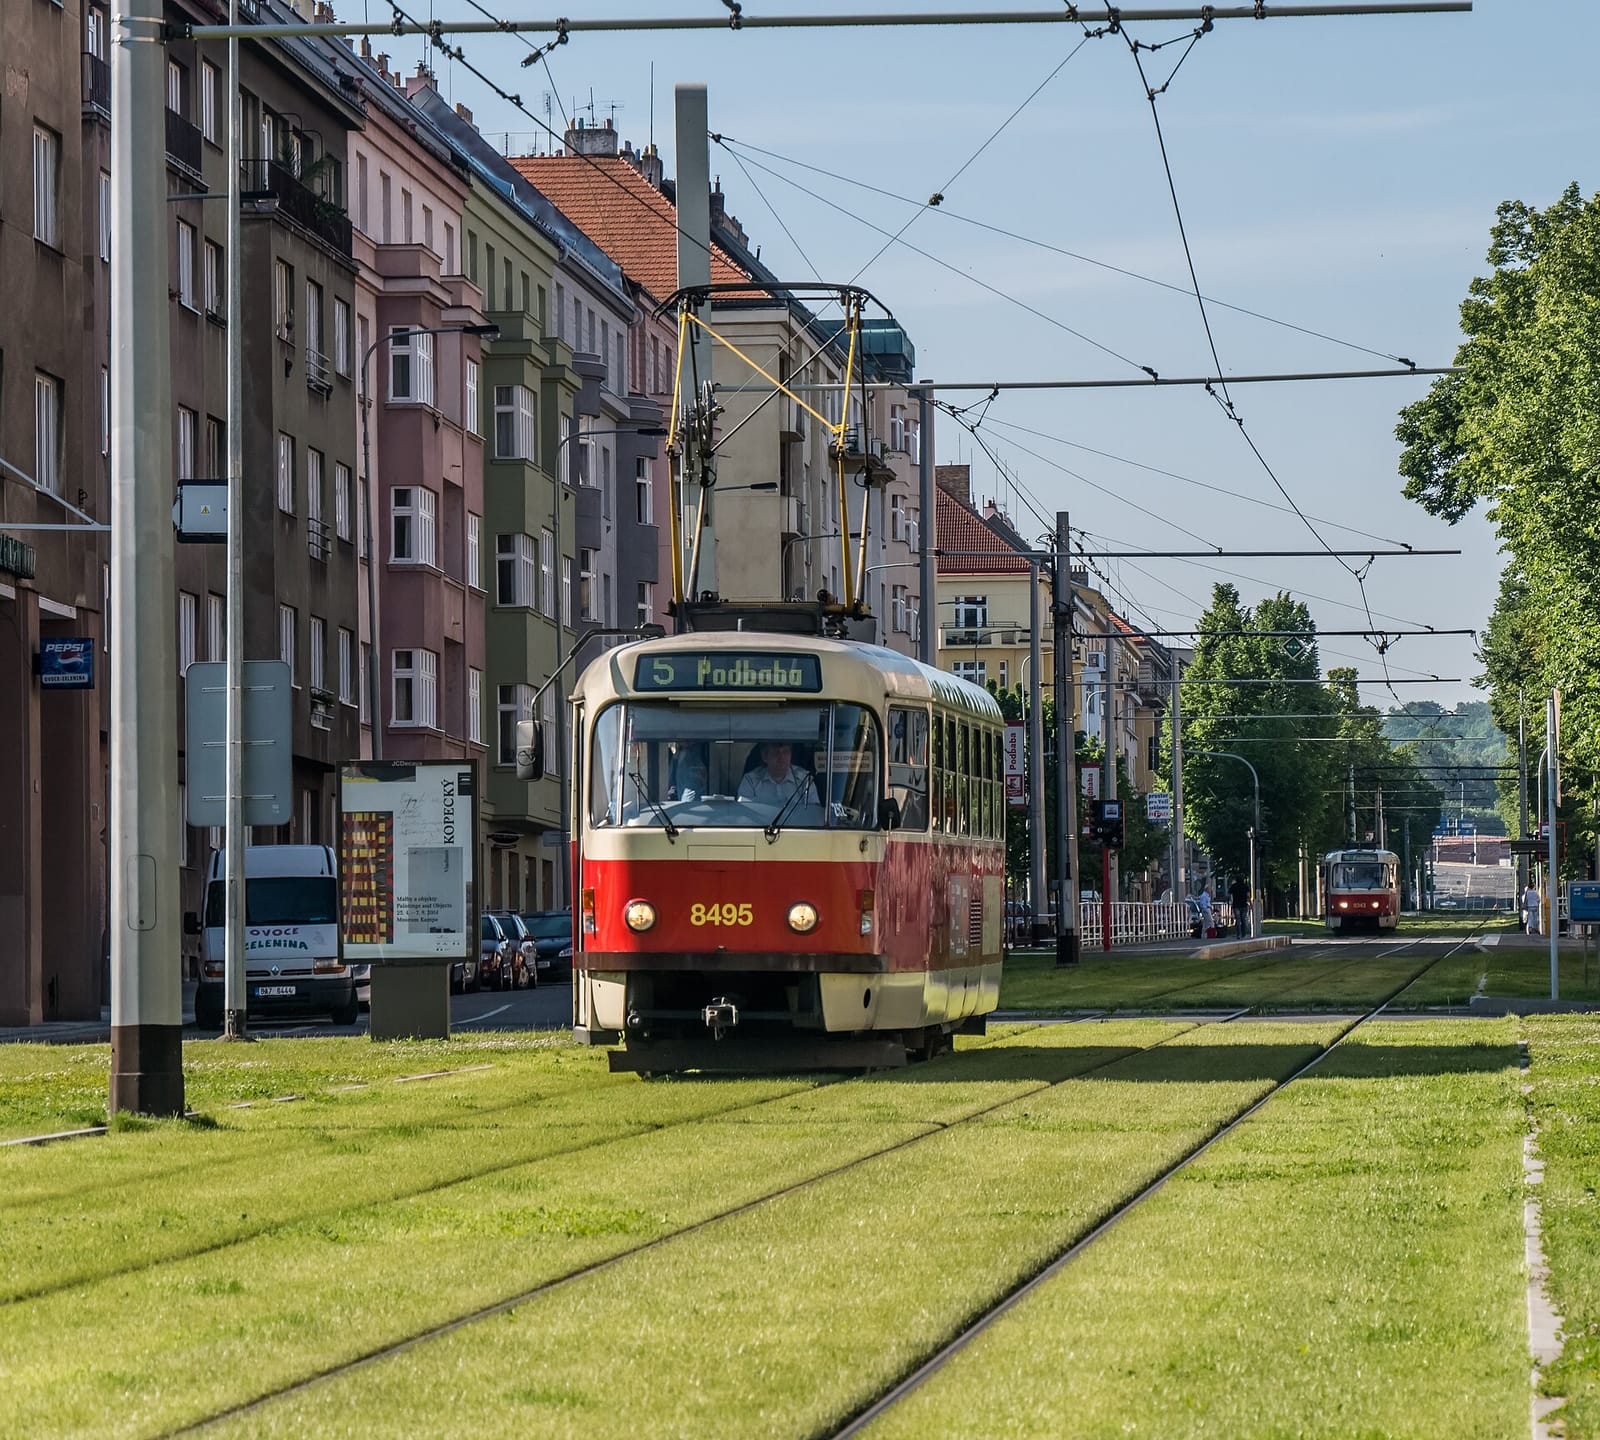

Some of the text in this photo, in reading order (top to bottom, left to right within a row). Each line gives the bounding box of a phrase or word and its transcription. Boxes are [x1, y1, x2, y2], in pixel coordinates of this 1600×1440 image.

[45, 643, 85, 652] PEPSI
[653, 657, 803, 686] 5 Podbaba
[1009, 732, 1017, 770] Podbaba
[441, 779, 454, 844] KOPECKÝ
[690, 903, 754, 926] 8495
[250, 927, 300, 937] OVOCE
